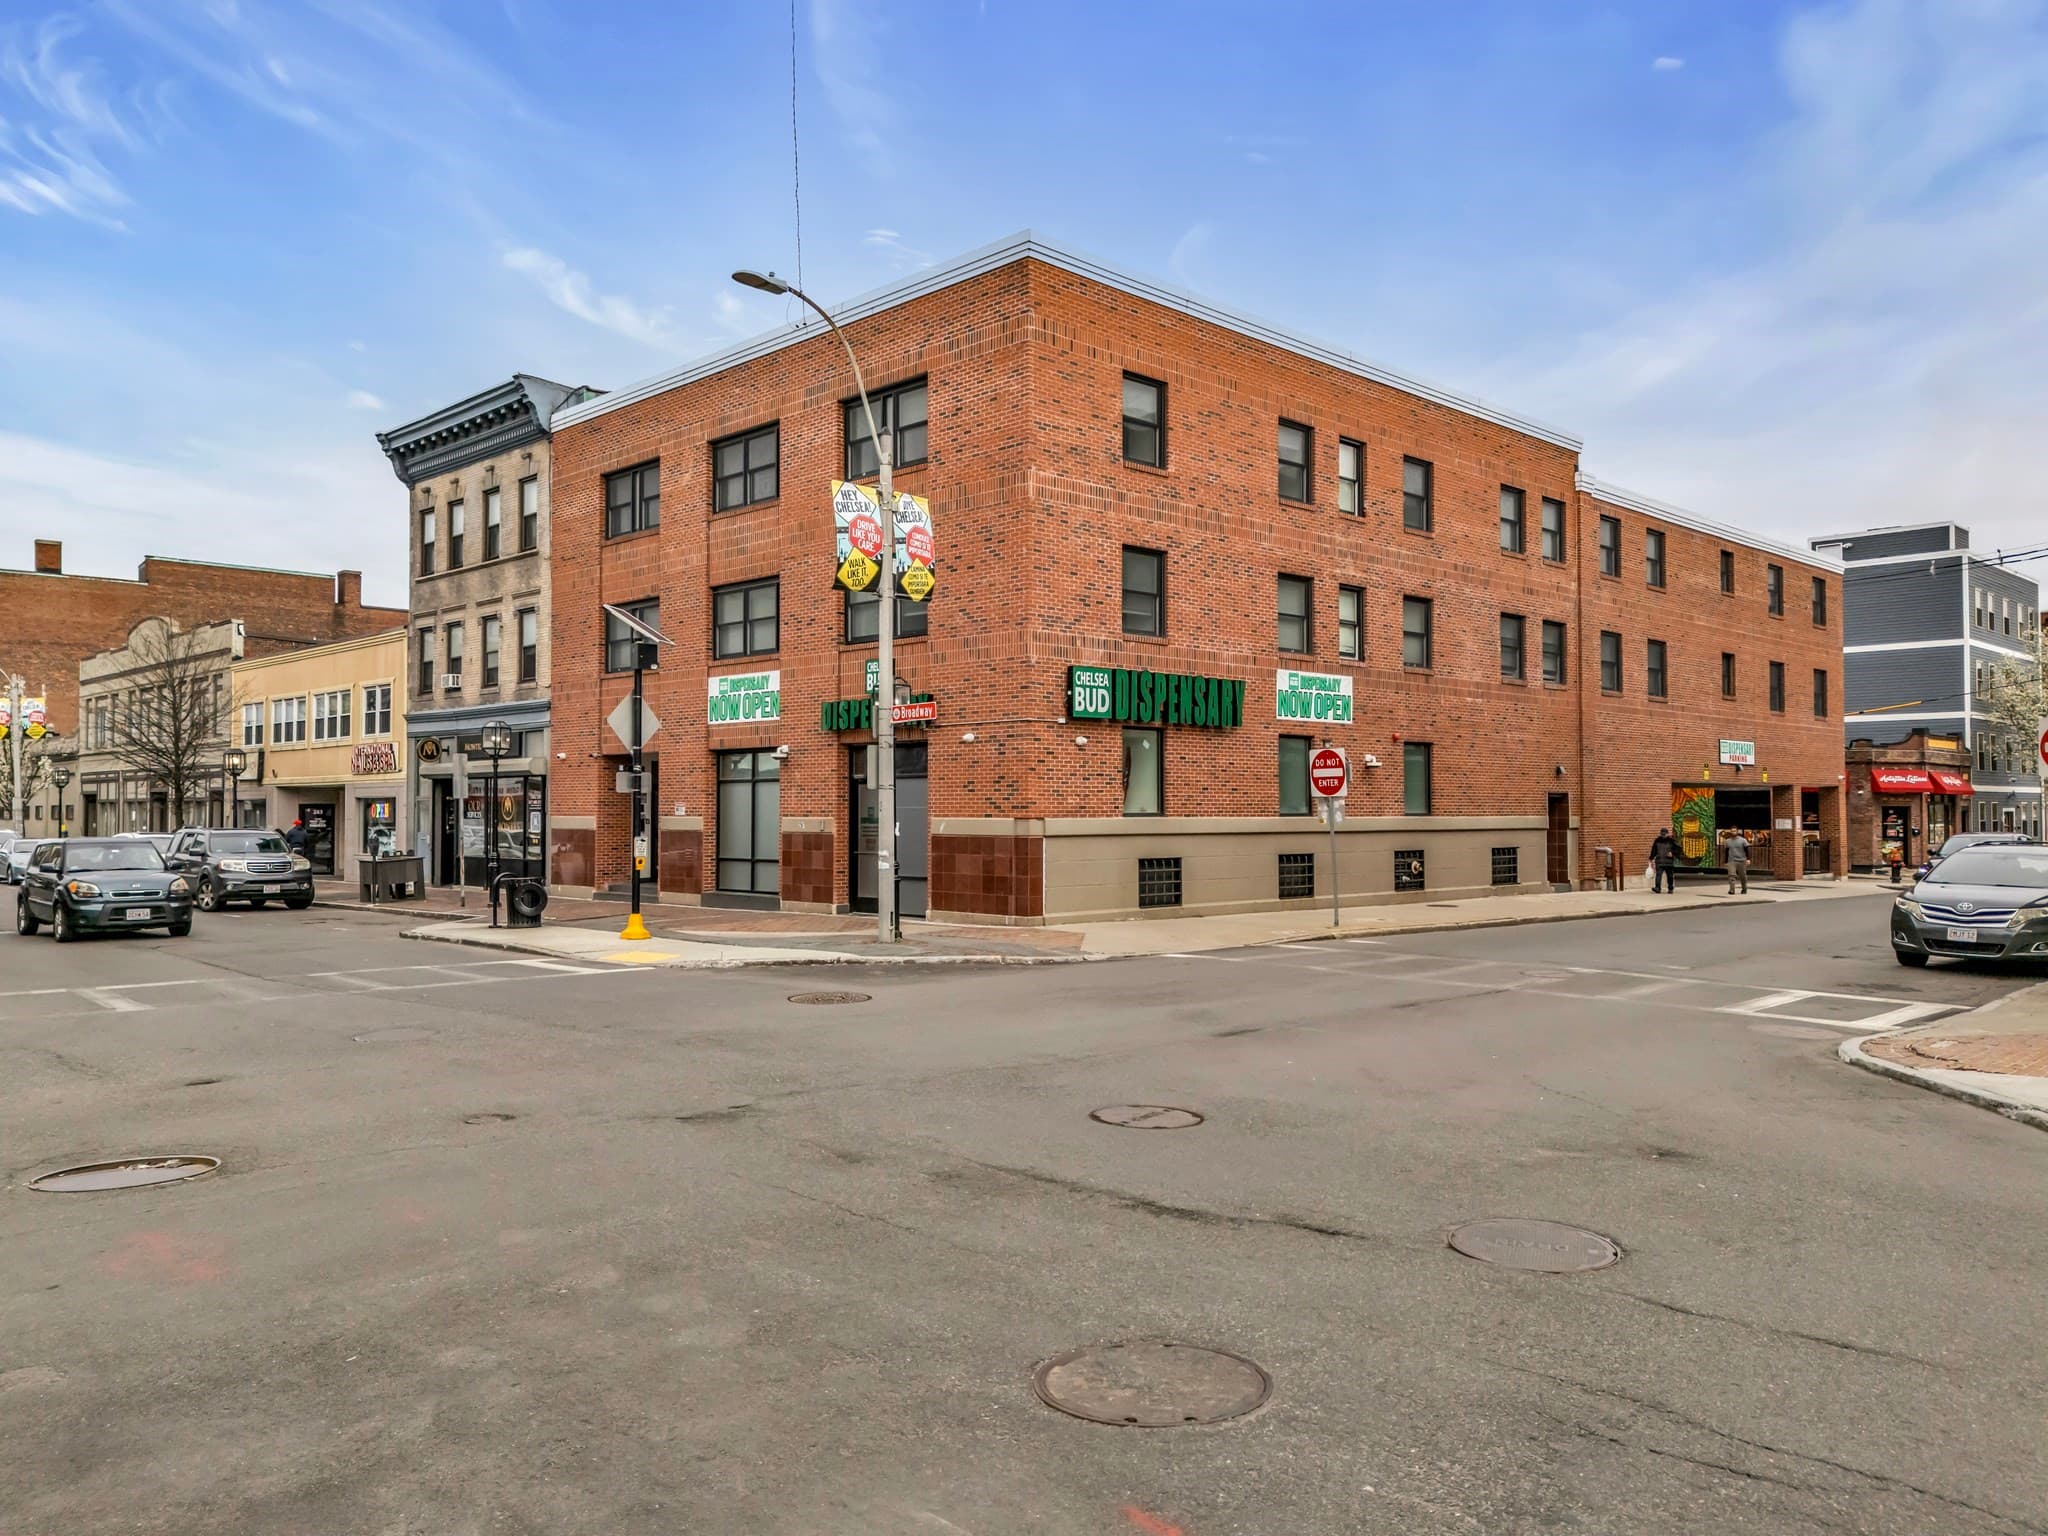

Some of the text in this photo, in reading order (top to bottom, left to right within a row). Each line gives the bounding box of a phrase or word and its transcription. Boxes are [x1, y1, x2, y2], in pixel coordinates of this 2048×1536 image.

[840, 489, 858, 501] HEY
[836, 501, 872, 513] CHELSEA!
[857, 519, 876, 532] DRIVE
[852, 528, 880, 544] LIKE YOU
[847, 557, 866, 569] WALK
[847, 568, 861, 579] LIKE
[867, 662, 879, 672] CHEL
[1075, 671, 1109, 687] CHELSEA
[709, 690, 780, 721] NOW OPEN
[1075, 688, 1110, 713] BUD
[1115, 669, 1246, 728] DISPENSARY
[1278, 690, 1351, 721] NOW OPEN
[901, 704, 932, 719] Broadway
[1315, 758, 1340, 767] DO NOT
[1318, 778, 1339, 787] ENTER
[371, 802, 390, 818] OPEN
